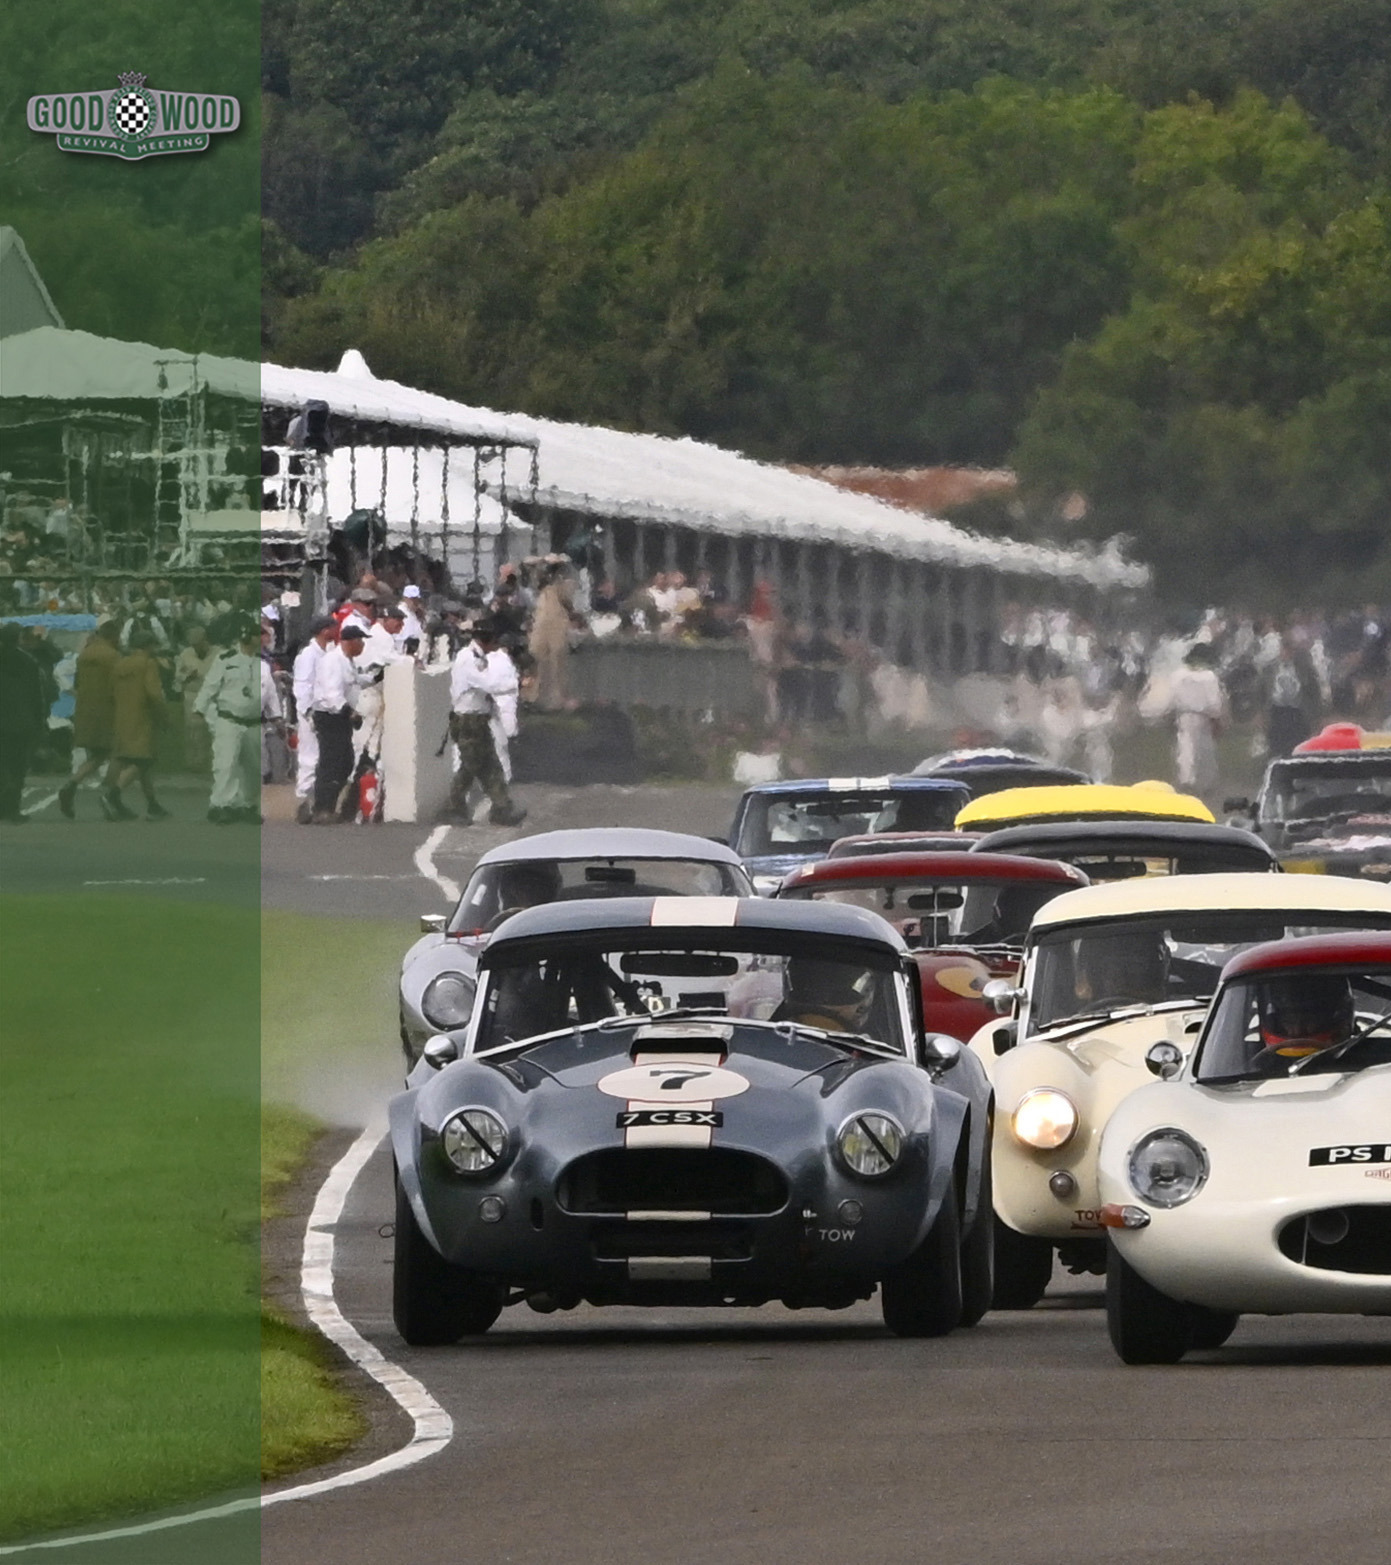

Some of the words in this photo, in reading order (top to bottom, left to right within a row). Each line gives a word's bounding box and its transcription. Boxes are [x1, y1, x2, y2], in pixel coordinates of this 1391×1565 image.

[649, 1069, 713, 1090] 7
[623, 1113, 640, 1125] 7
[650, 1112, 717, 1124] CSX
[1328, 1147, 1373, 1163] PS
[818, 1228, 856, 1242] TOW
